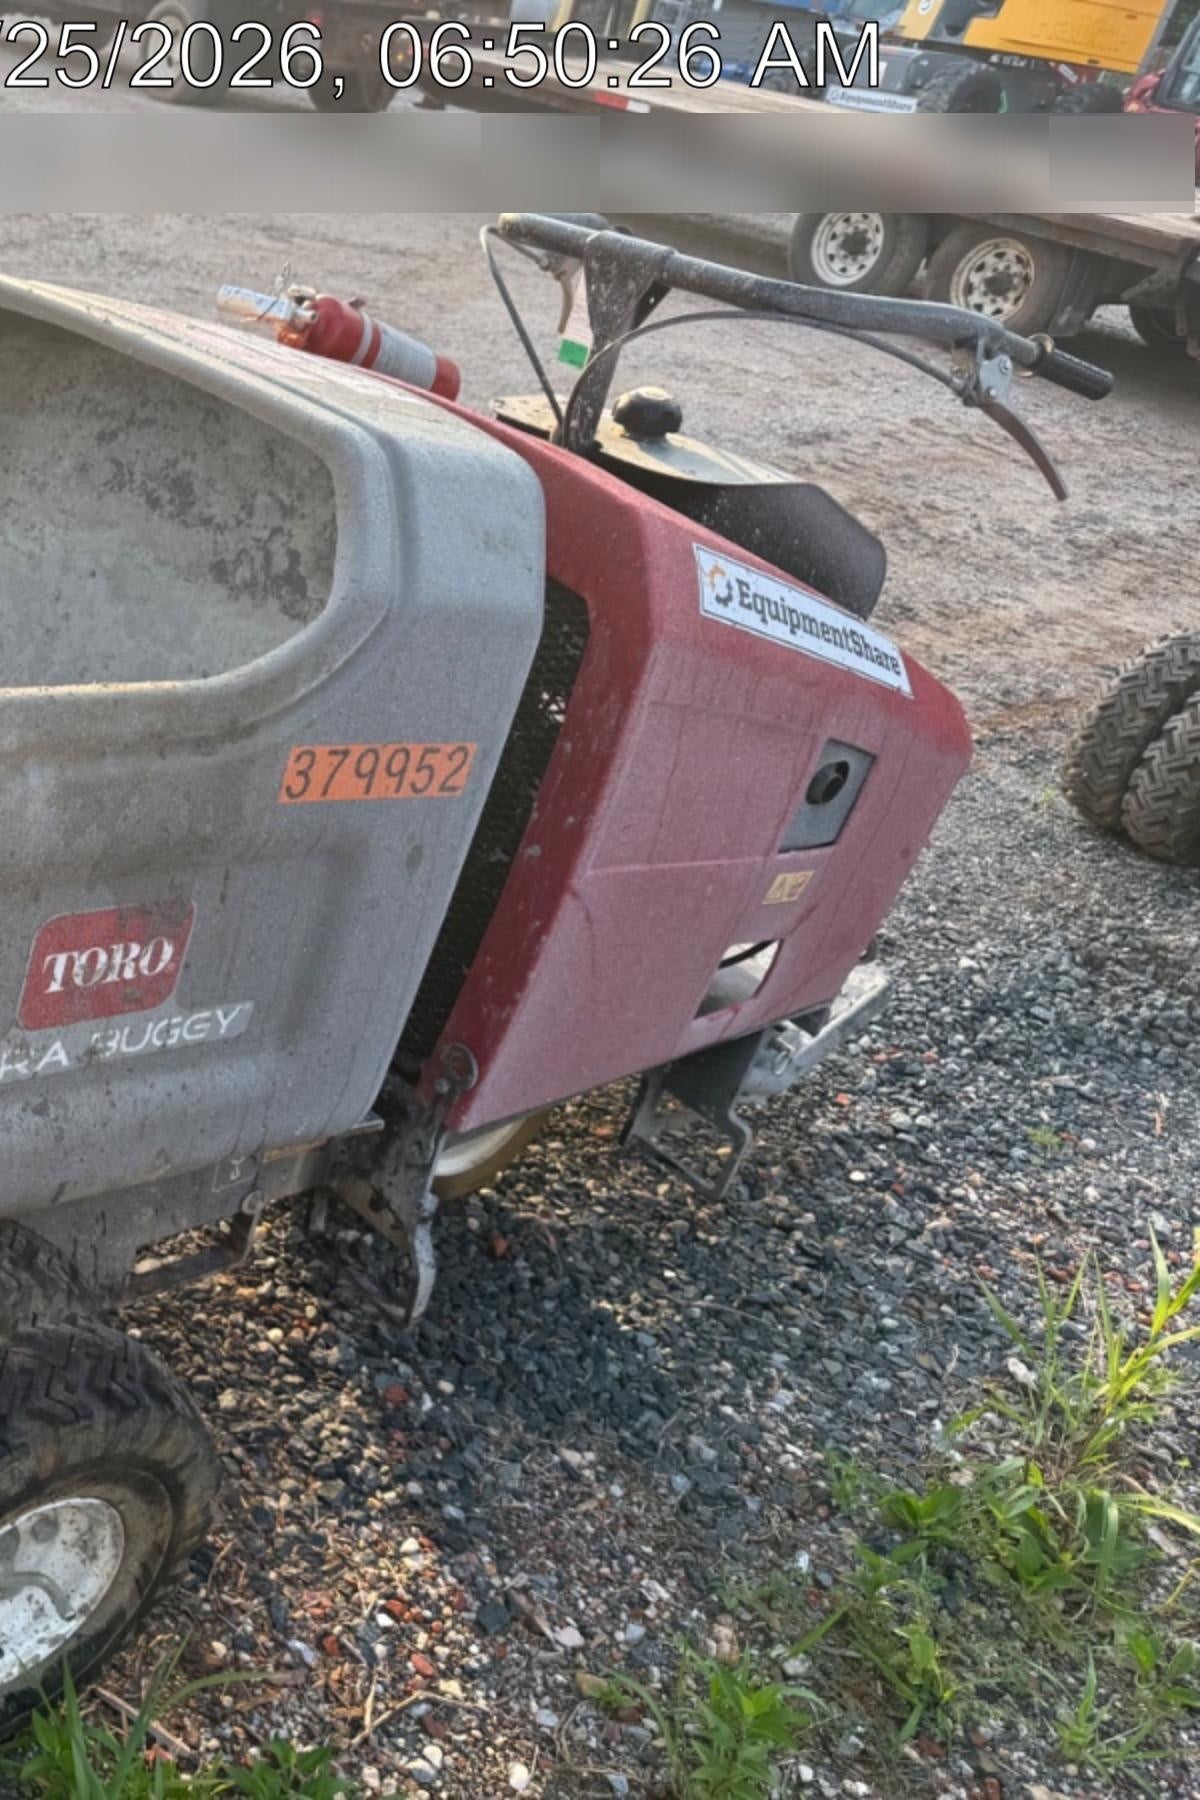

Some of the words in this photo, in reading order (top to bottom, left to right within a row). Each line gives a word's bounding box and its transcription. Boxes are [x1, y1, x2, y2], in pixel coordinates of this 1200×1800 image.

[735, 577, 902, 677] EquipmentShare
[285, 745, 470, 799] 379952
[42, 936, 175, 994] TORO
[91, 1004, 246, 1058] BUGGY
